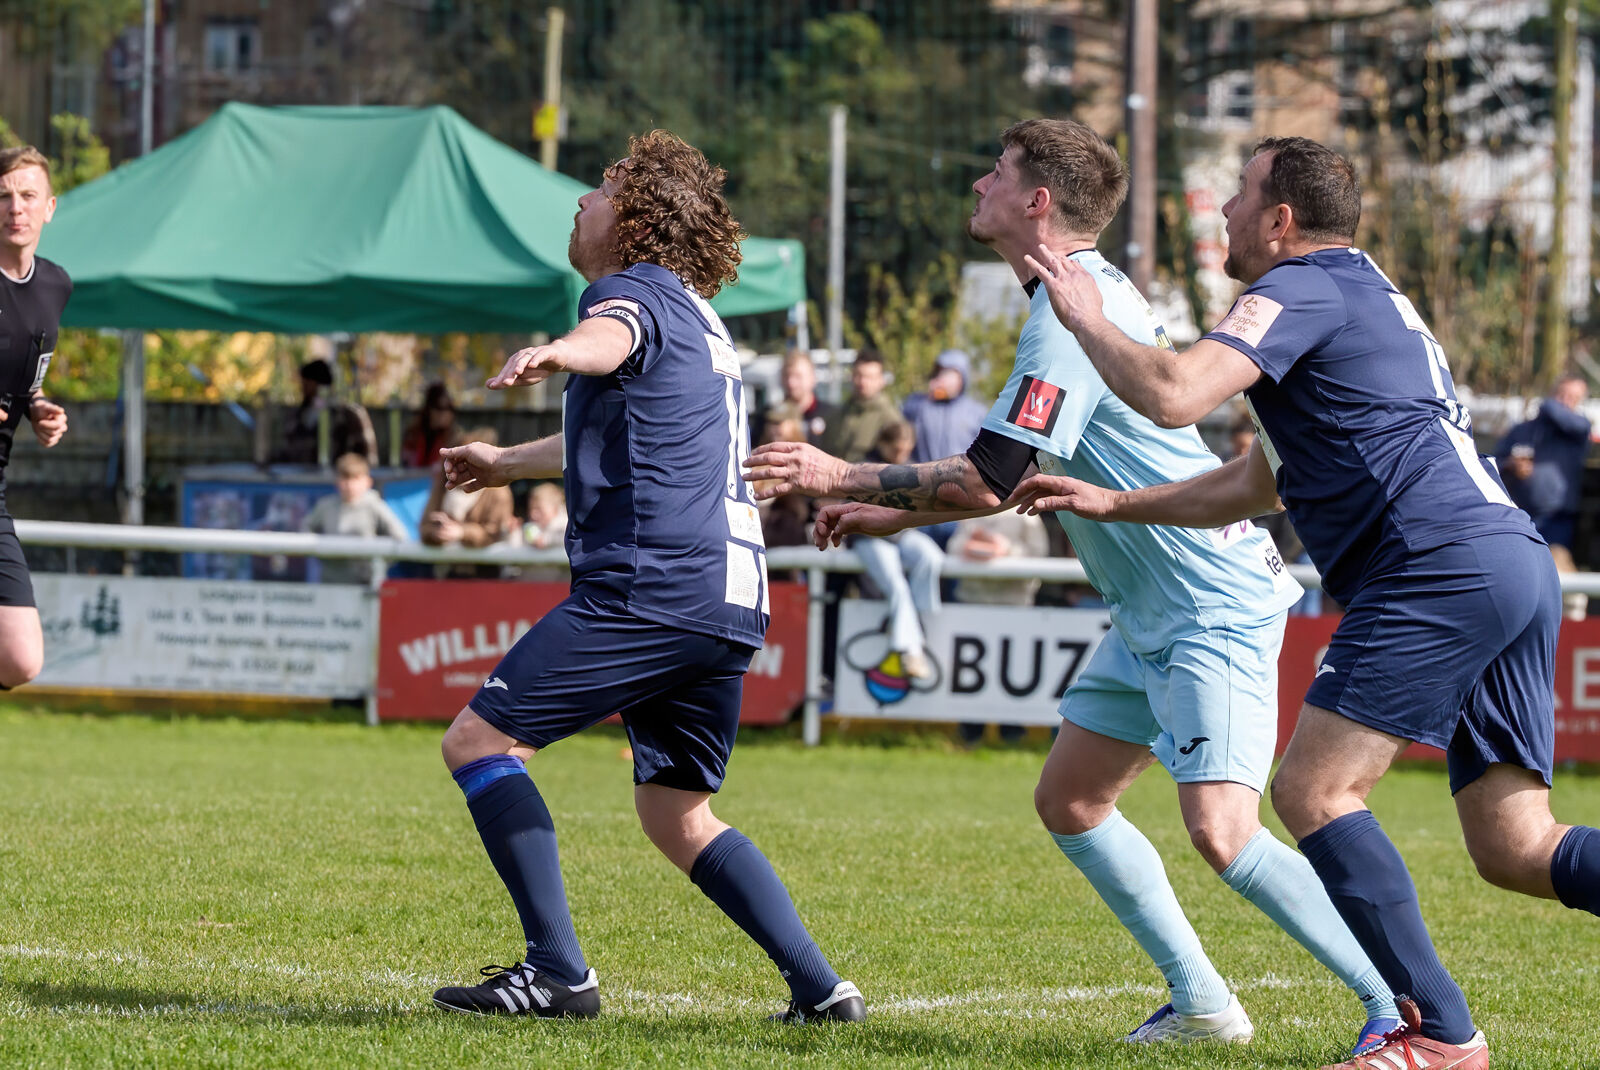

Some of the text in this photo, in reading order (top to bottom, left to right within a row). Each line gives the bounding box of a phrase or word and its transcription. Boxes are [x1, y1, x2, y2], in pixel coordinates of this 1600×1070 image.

[1243, 306, 1258, 317] The
[1228, 313, 1260, 328] Copper
[1231, 322, 1249, 334] Fox
